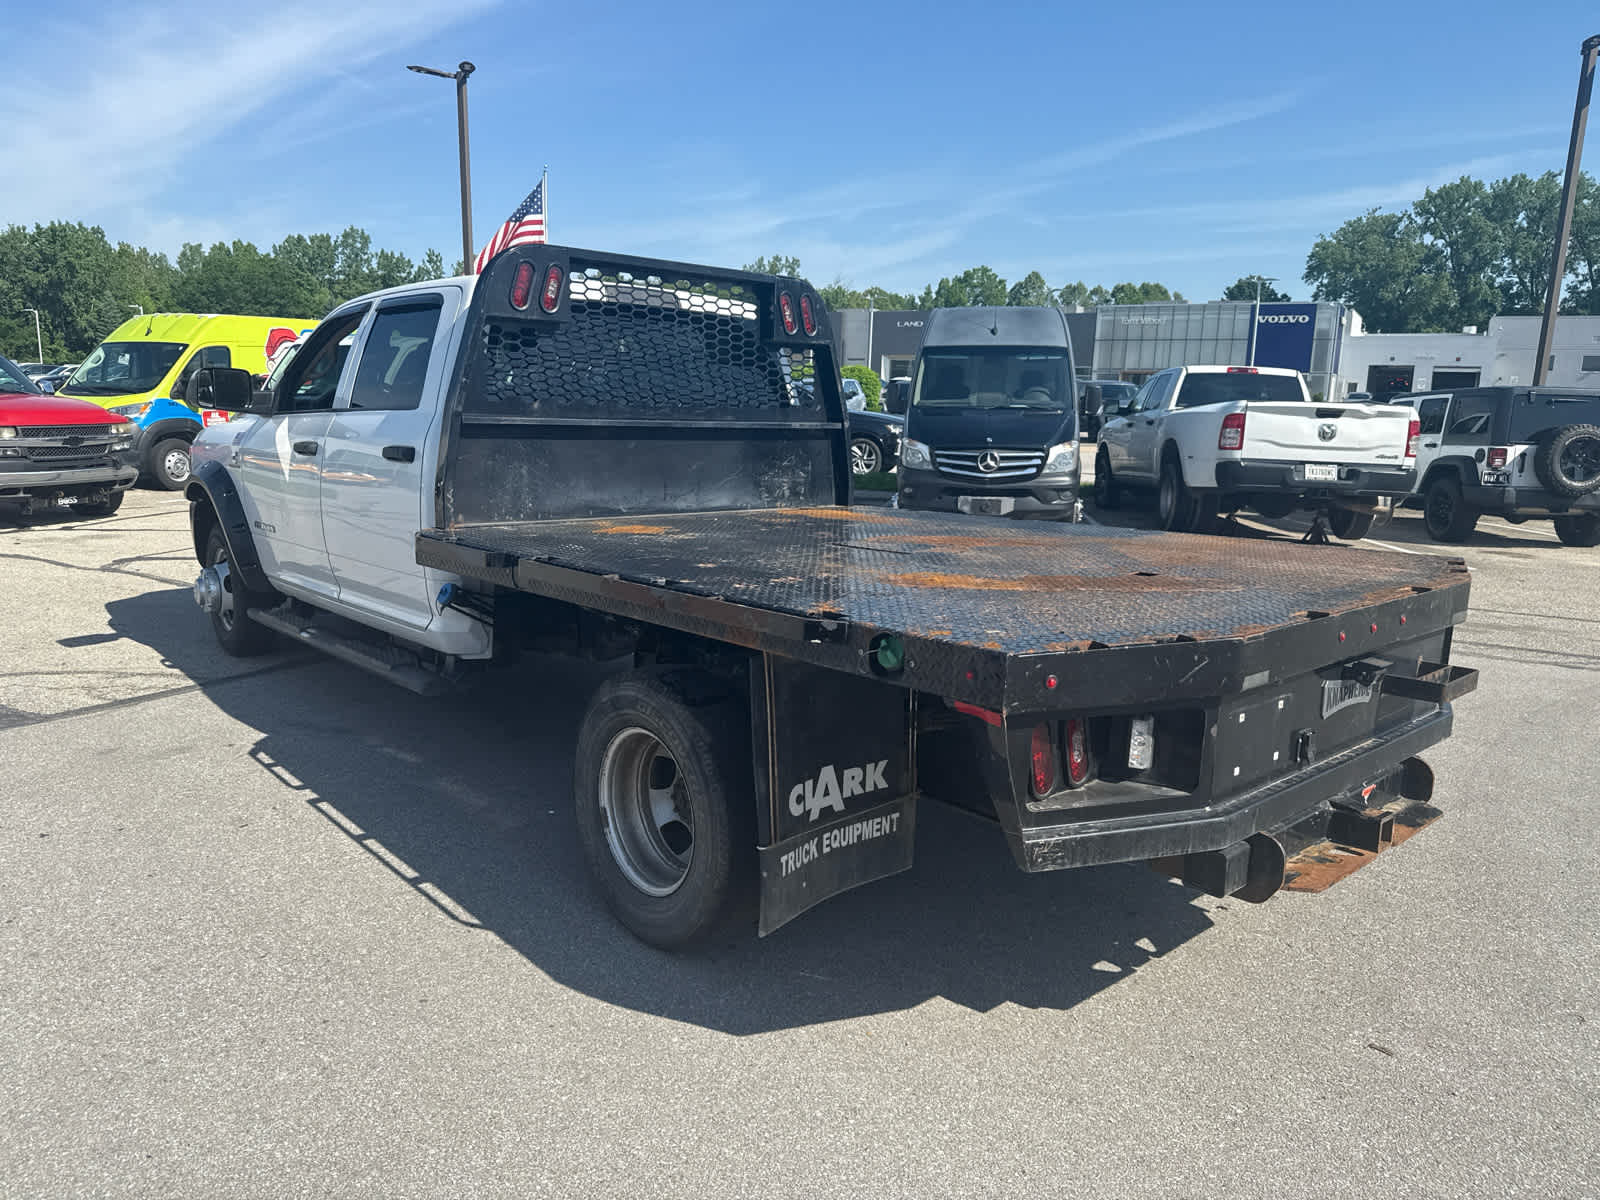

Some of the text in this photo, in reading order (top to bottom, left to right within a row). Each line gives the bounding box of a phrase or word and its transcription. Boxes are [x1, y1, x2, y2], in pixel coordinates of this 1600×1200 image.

[896, 320, 924, 328] LAND
[1258, 315, 1310, 324] VOLVO
[788, 759, 889, 822] CLARK
[780, 812, 900, 878] TRUCK EQUIPMENT
